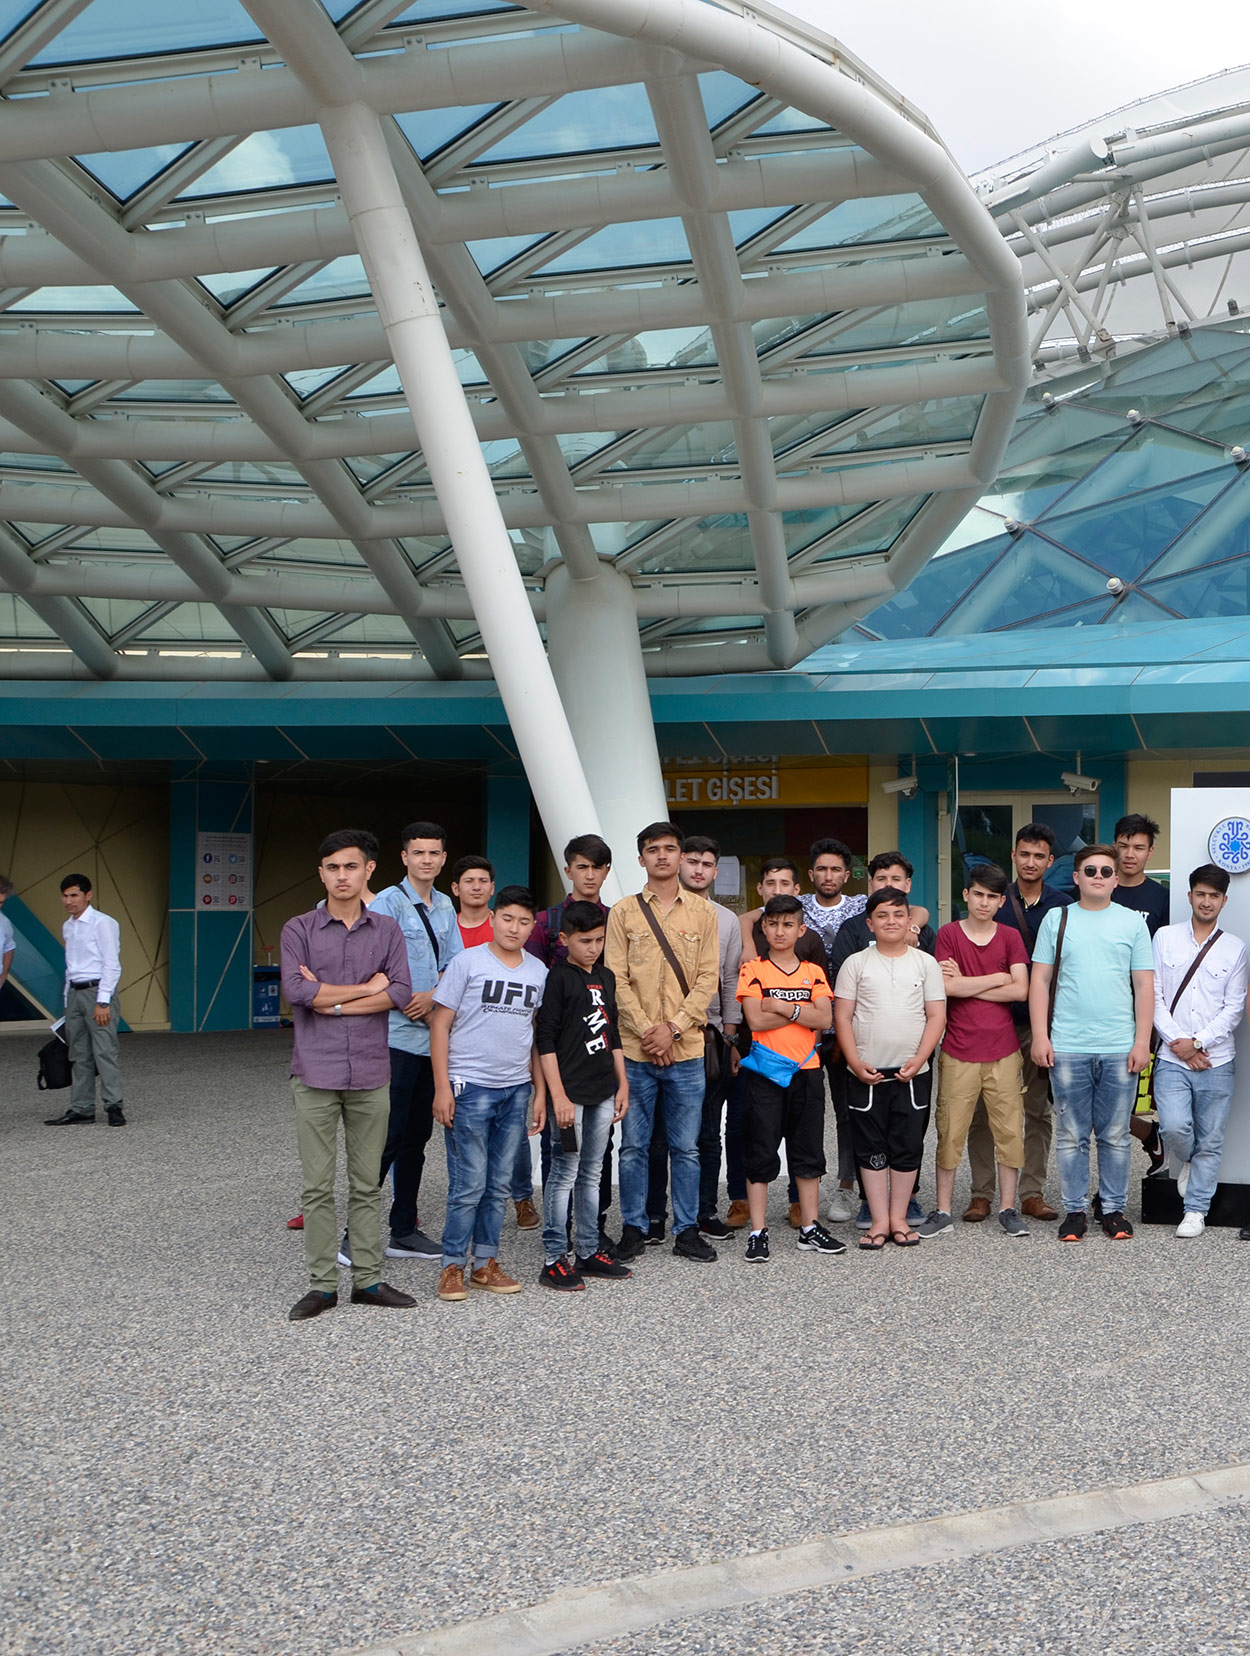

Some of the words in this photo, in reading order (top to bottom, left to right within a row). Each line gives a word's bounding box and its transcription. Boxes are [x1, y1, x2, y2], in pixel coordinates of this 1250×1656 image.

[665, 778, 702, 802] LET
[707, 769, 779, 805] GİŞESİ
[481, 980, 537, 1009] UFC
[769, 988, 811, 1000] Kappa
